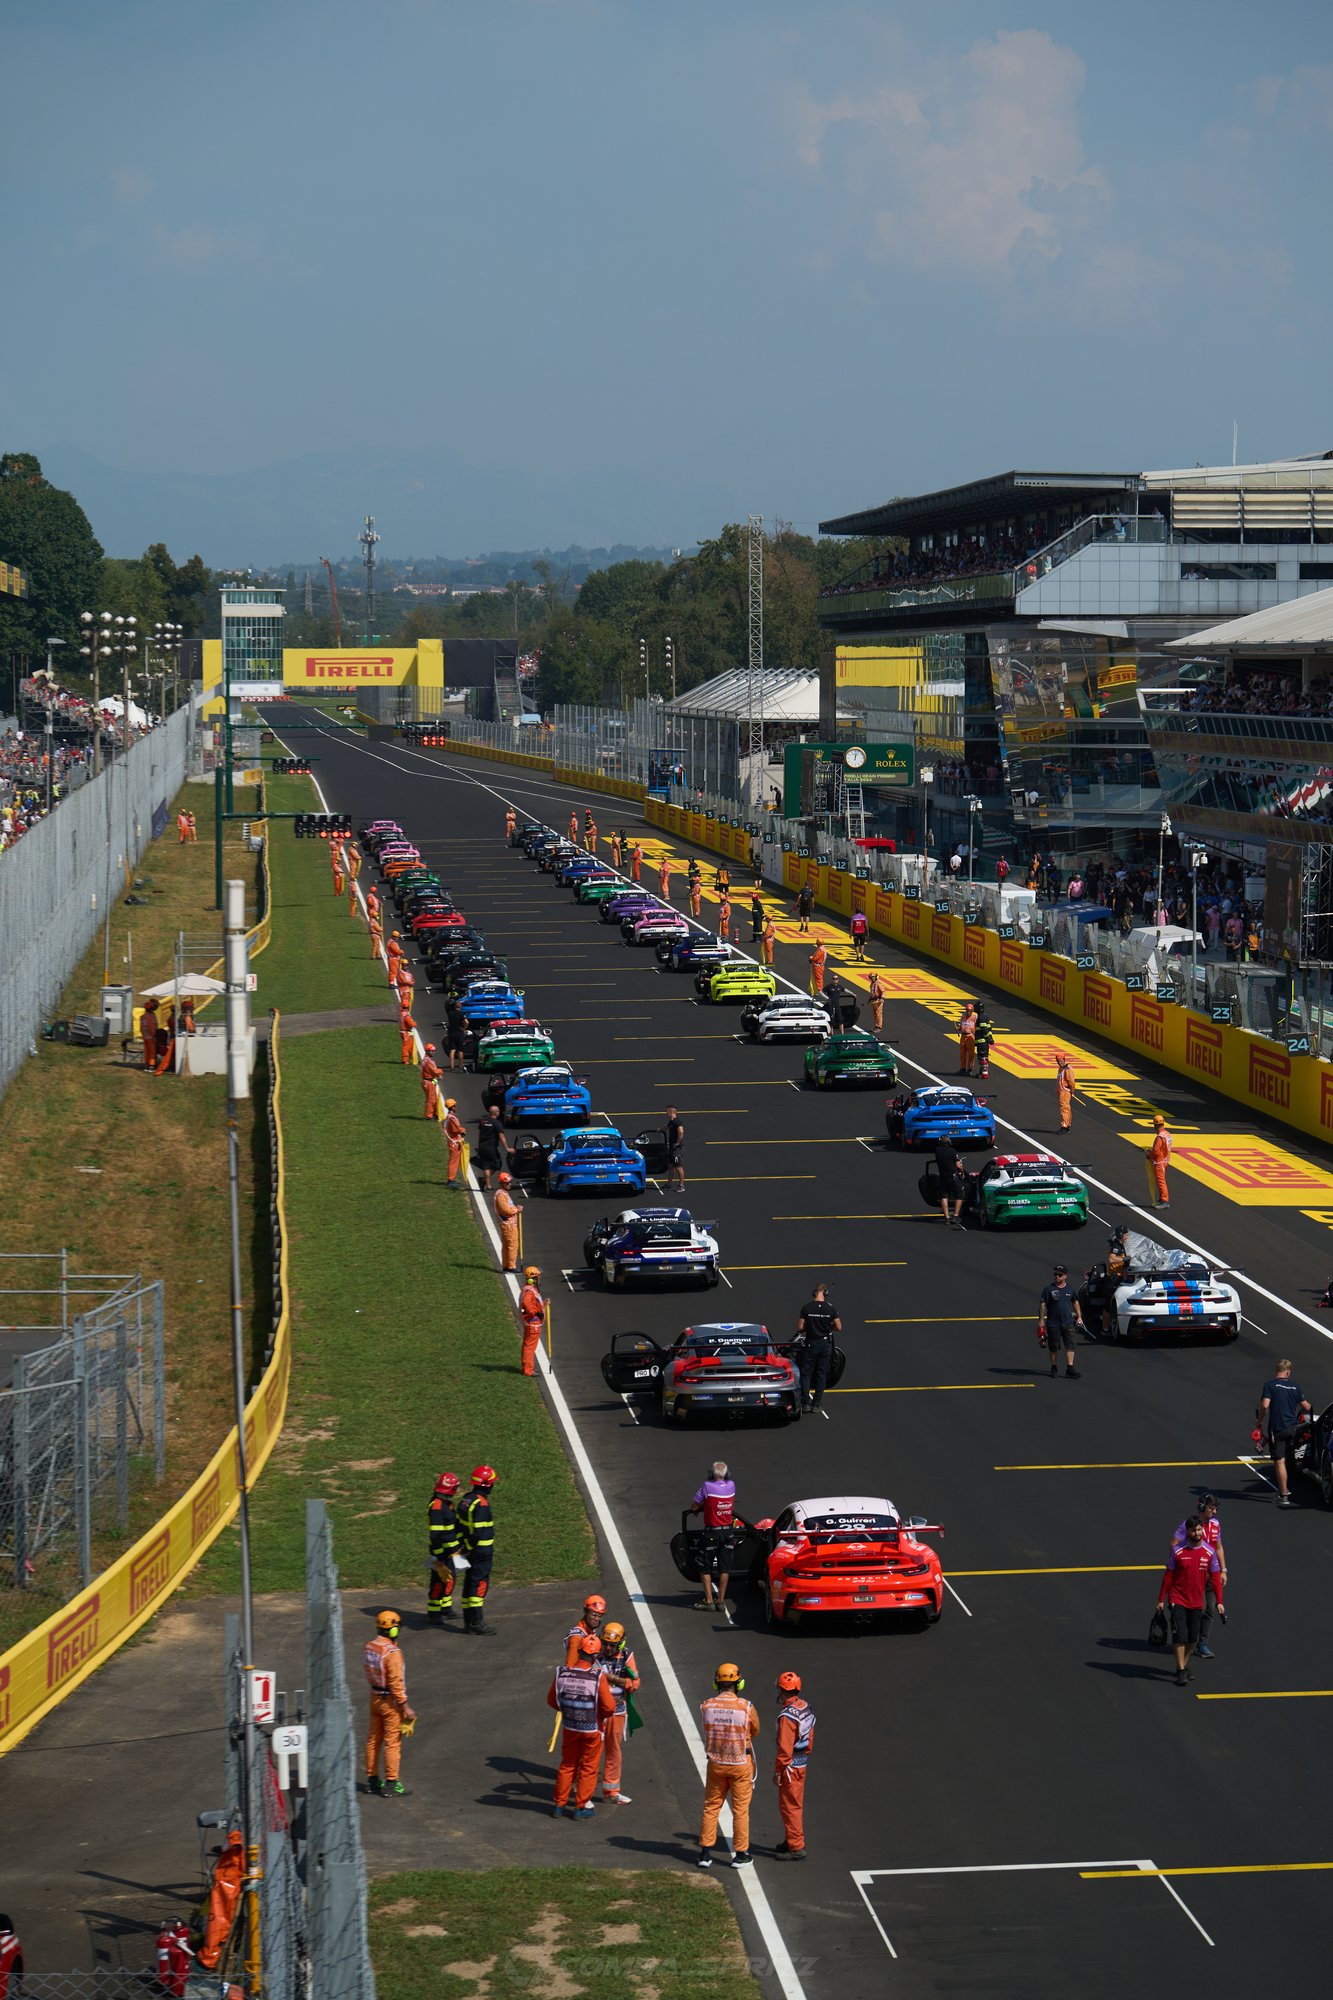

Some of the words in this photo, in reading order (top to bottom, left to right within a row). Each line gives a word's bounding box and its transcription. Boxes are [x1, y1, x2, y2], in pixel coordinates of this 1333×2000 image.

[306, 657, 394, 677] PIRELLI
[875, 760, 907, 768] ROLEX
[799, 848, 808, 856] 10
[837, 861, 846, 869] 12
[857, 870, 867, 878] 13
[883, 882, 894, 890] 14
[906, 888, 917, 896] 15
[936, 902, 949, 911] 16
[965, 914, 977, 924] 17
[932, 913, 951, 955] PIRELLI
[1000, 928, 1014, 937] 18
[1030, 936, 1044, 946] 19
[963, 927, 985, 970] PIRELLI
[1000, 941, 1024, 988] PIRELLI
[1077, 957, 1094, 968] 20
[1039, 956, 1066, 1007] PIRELLI
[1127, 977, 1142, 988] 21
[1158, 988, 1175, 998] 22
[1083, 974, 1112, 1028] PIRELLI
[1212, 1008, 1230, 1019] 23
[1131, 994, 1164, 1052] PIRELLI
[1186, 1017, 1223, 1079] PIRELLI
[1287, 1038, 1309, 1052] 24
[1249, 1043, 1291, 1110] PIRELLI
[1169, 1147, 1333, 1189] PIRELLI
[191, 1468, 221, 1549] PIRELLI
[130, 1527, 171, 1617] PIRELLI
[47, 1591, 100, 1690] PIRELLI
